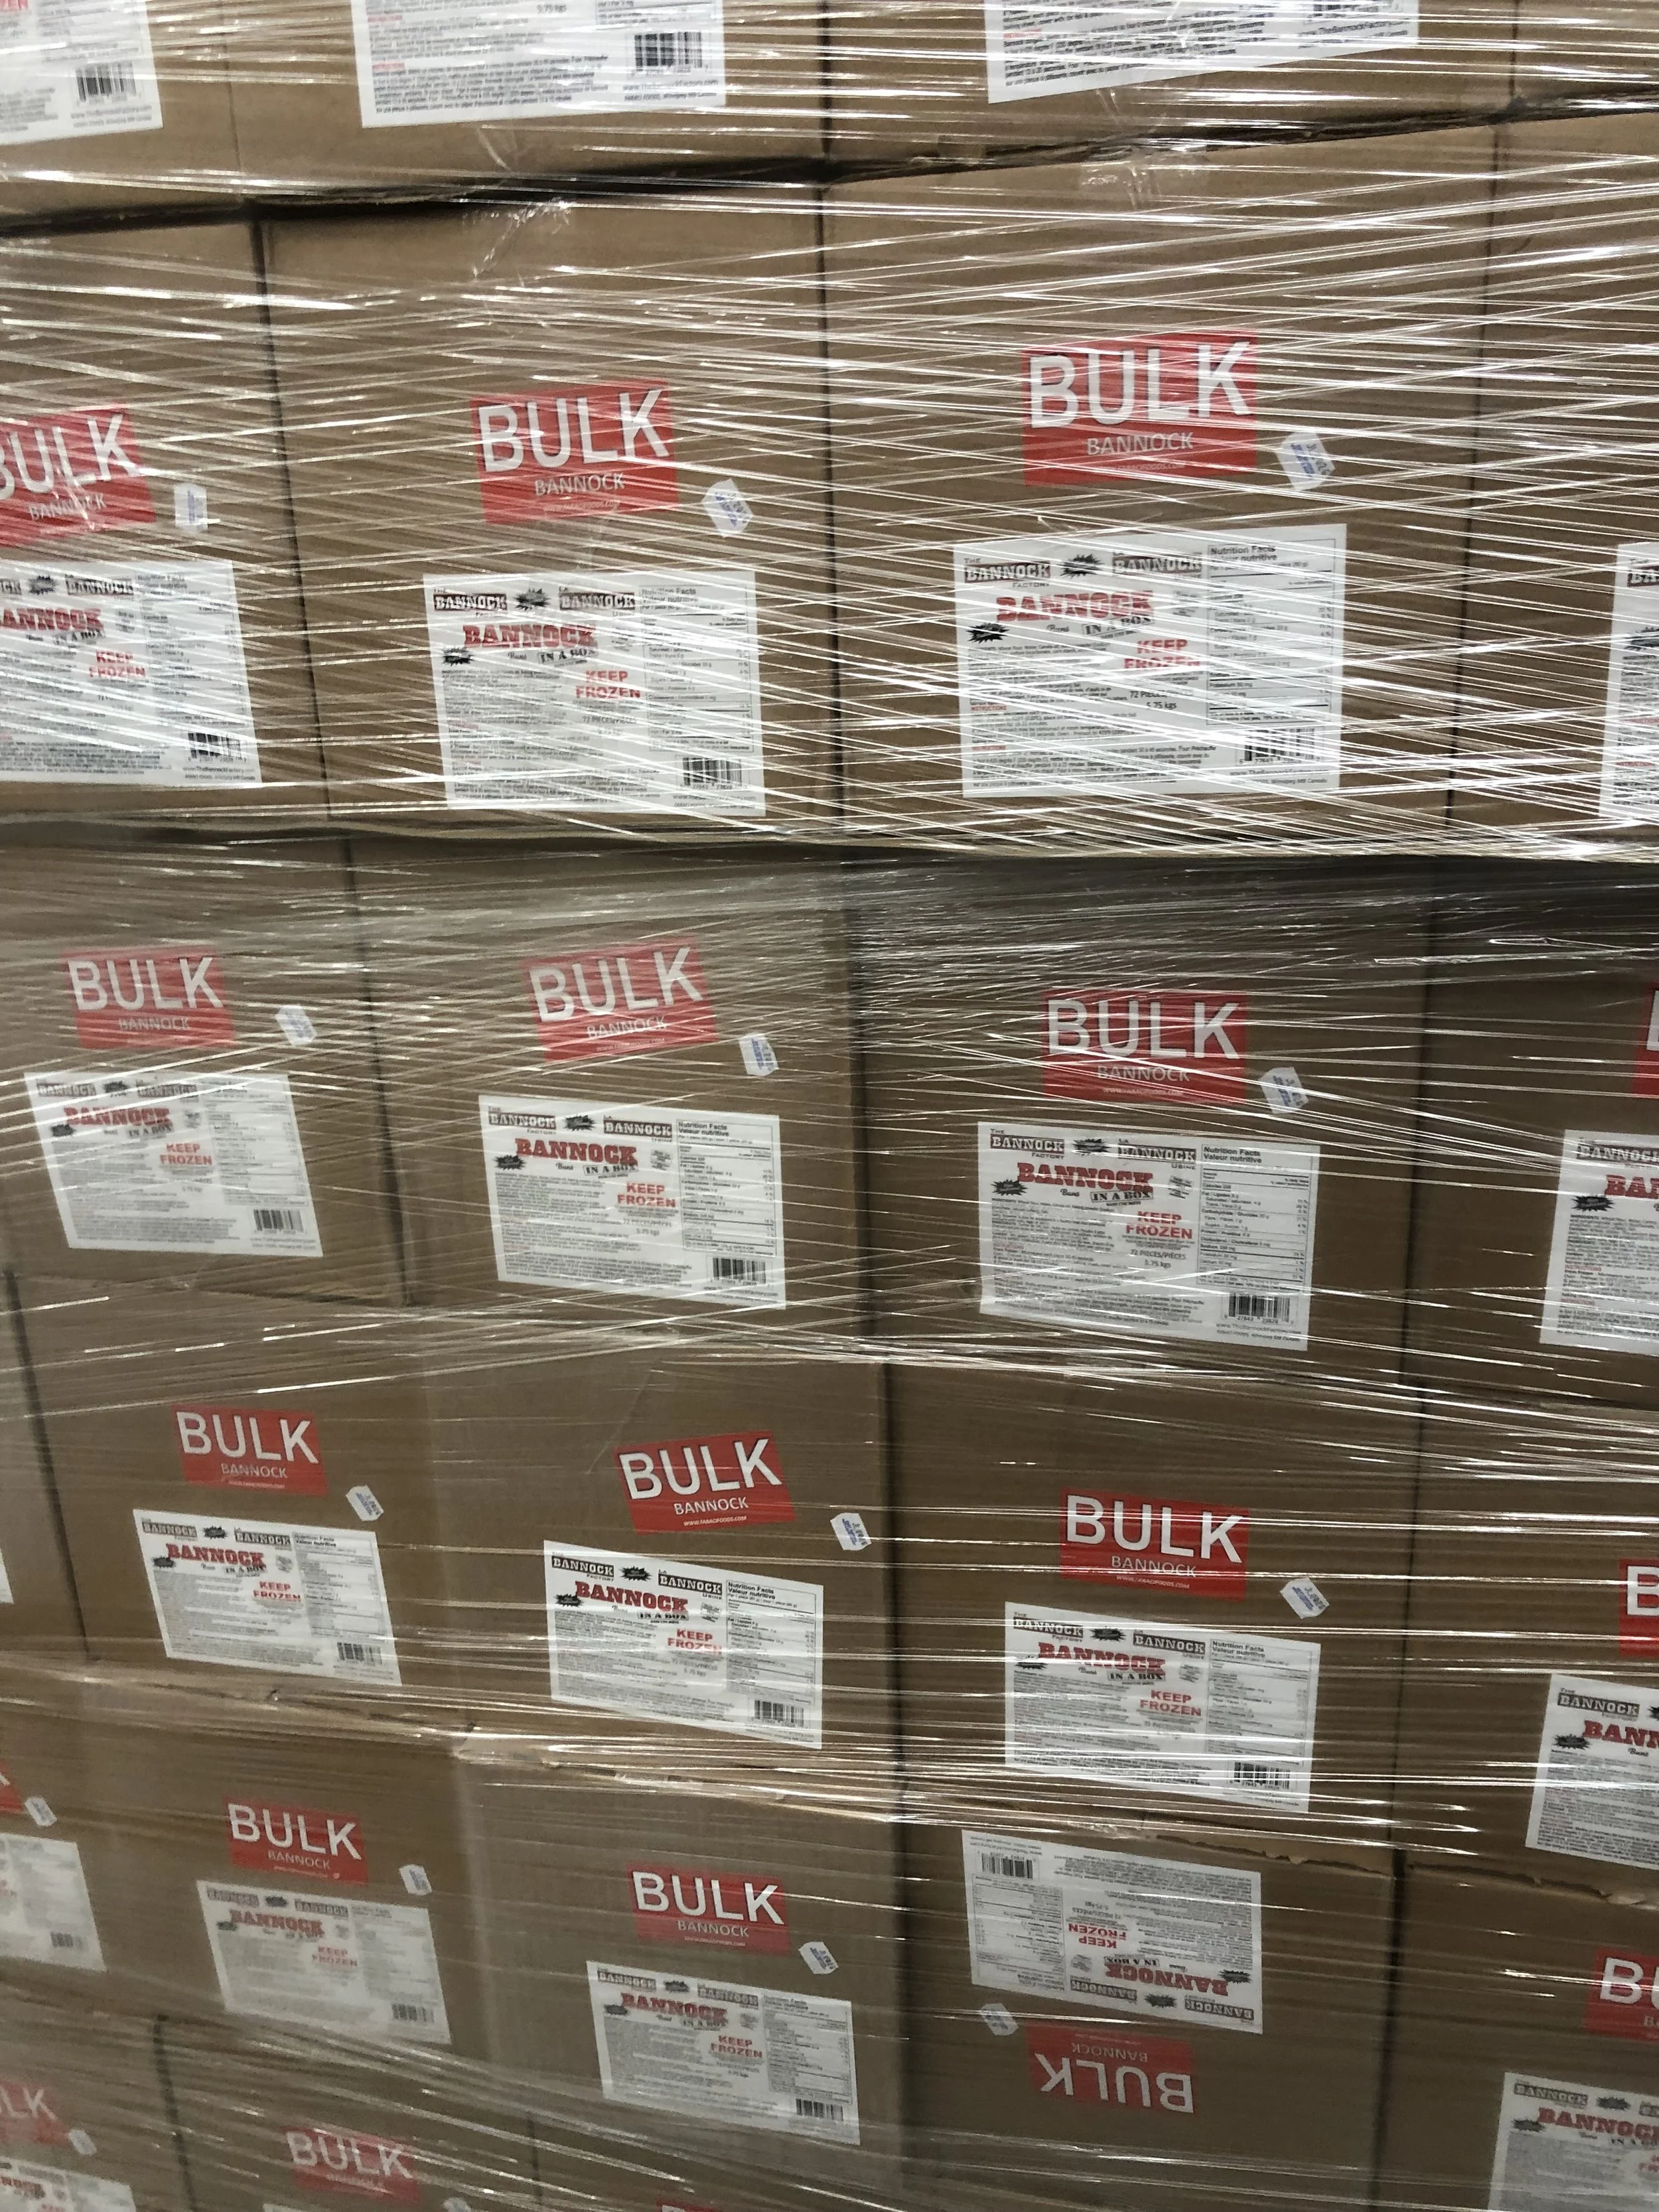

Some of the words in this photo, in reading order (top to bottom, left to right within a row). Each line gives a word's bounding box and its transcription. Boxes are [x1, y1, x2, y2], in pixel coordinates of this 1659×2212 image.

[1028, 340, 1254, 428] BULK
[478, 388, 670, 473] BULK
[1086, 432, 1194, 456] BANNOCK
[534, 473, 626, 496] BANNOCK
[29, 492, 107, 520] BANNCK
[965, 564, 1050, 583] BANNOCK
[435, 595, 507, 610] BANNOCK
[997, 591, 1154, 621] BANNOCK
[3, 609, 104, 630] ANNOCK
[463, 625, 597, 648] BANNOCK
[1137, 639, 1188, 653] KEEP
[585, 670, 628, 682] KEEP
[576, 686, 641, 699] FROZEN
[68, 956, 224, 1010] BULK
[529, 947, 703, 1022] BULK
[1048, 999, 1240, 1060] BULK
[1097, 1065, 1190, 1082] BANNOCK
[64, 1106, 171, 1126] BANNOCK
[489, 1112, 557, 1130] BANNOCK
[604, 1119, 672, 1138] BANNOCK
[166, 1143, 200, 1153] KEEP
[516, 1138, 639, 1166] BANNOCK
[991, 1134, 1064, 1154] BANNOCK
[1118, 1144, 1196, 1163] BANNOCK
[1204, 1146, 1238, 1155] Nutrition
[160, 1155, 212, 1166] FROZEN
[1577, 1144, 1659, 1165] BANNOC
[1017, 1162, 1154, 1193] BANNOCK
[626, 1183, 665, 1195] KEEP
[1093, 1192, 1108, 1201] IN
[1125, 1191, 1152, 1199] BOX
[617, 1195, 676, 1208] FROZEN
[1137, 1211, 1182, 1224] KEEP
[1125, 1224, 1193, 1239] FROZEN
[176, 1412, 319, 1463] BULK
[221, 1463, 287, 1479] BANNOCK
[619, 1438, 782, 1500] BULK
[674, 1497, 749, 1516] BANNOCK
[1066, 1495, 1243, 1564] BULK
[166, 1543, 266, 1567] BANNOCK
[551, 1556, 614, 1578] BANNOCK
[1112, 1555, 1197, 1578] BANNOCK
[259, 1581, 291, 1591] KEEP
[658, 1574, 723, 1595] BANNOCK
[728, 1582, 756, 1591] Nutrition
[253, 1590, 301, 1601] FROZEN
[575, 1581, 688, 1613] BANNOCK
[676, 1629, 713, 1642] KEEP
[1013, 1618, 1084, 1638] BANNOCK
[668, 1638, 722, 1655] FROZEN
[1133, 1633, 1206, 1655] BANNOCK
[1212, 1641, 1244, 1649] Nutrition
[1039, 1642, 1166, 1675] BANNOCK
[1151, 1690, 1192, 1704] KEEP
[1557, 1692, 1640, 1717] BANNOCK
[1139, 1699, 1202, 1716] FROZEN
[1583, 1720, 1659, 1749] BANN
[228, 1803, 362, 1860] BULK
[267, 1851, 331, 1870] BANNOCK
[632, 1871, 784, 1925] BULK
[678, 1920, 750, 1938] BANNOCK
[1068, 1923, 1127, 1941] FROZEN
[1078, 1937, 1118, 1949] KEEP
[1105, 1963, 1229, 1996] BANNOCK
[620, 1992, 728, 2024] BANNOCK
[711, 2043, 762, 2058] FROZEN
[718, 2035, 753, 2047] KEEP
[1072, 2042, 1148, 2062] BANNOCK
[1035, 2053, 1194, 2114] BULK
[0, 2087, 58, 2120] LK
[285, 2130, 413, 2180] BULK
